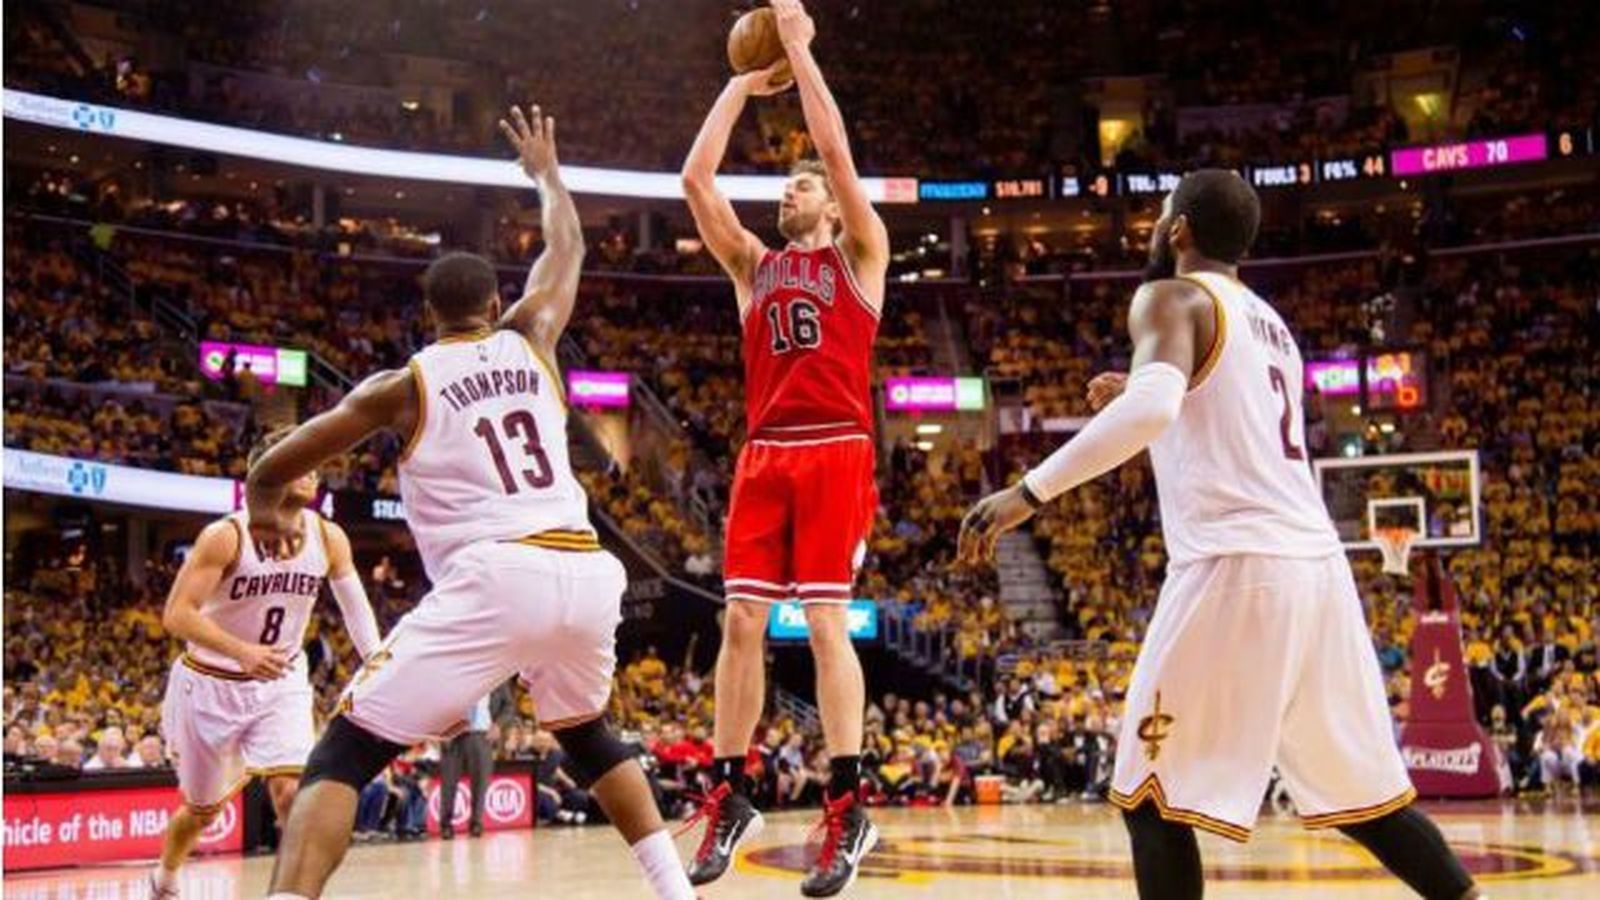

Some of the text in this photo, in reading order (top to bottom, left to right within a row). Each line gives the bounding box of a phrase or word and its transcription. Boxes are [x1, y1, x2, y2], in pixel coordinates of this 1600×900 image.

[1423, 141, 1508, 170] CAVS 70
[1560, 133, 1572, 154] 6
[1300, 163, 1310, 184] 3
[1363, 156, 1384, 176] 44
[768, 299, 821, 353] 16
[440, 369, 540, 412] THOMPSON
[1267, 364, 1304, 461] 2
[473, 409, 555, 496] 13
[259, 606, 285, 646] 8
[58, 814, 82, 842] of
[88, 813, 123, 840] the
[130, 809, 169, 837] NBA
